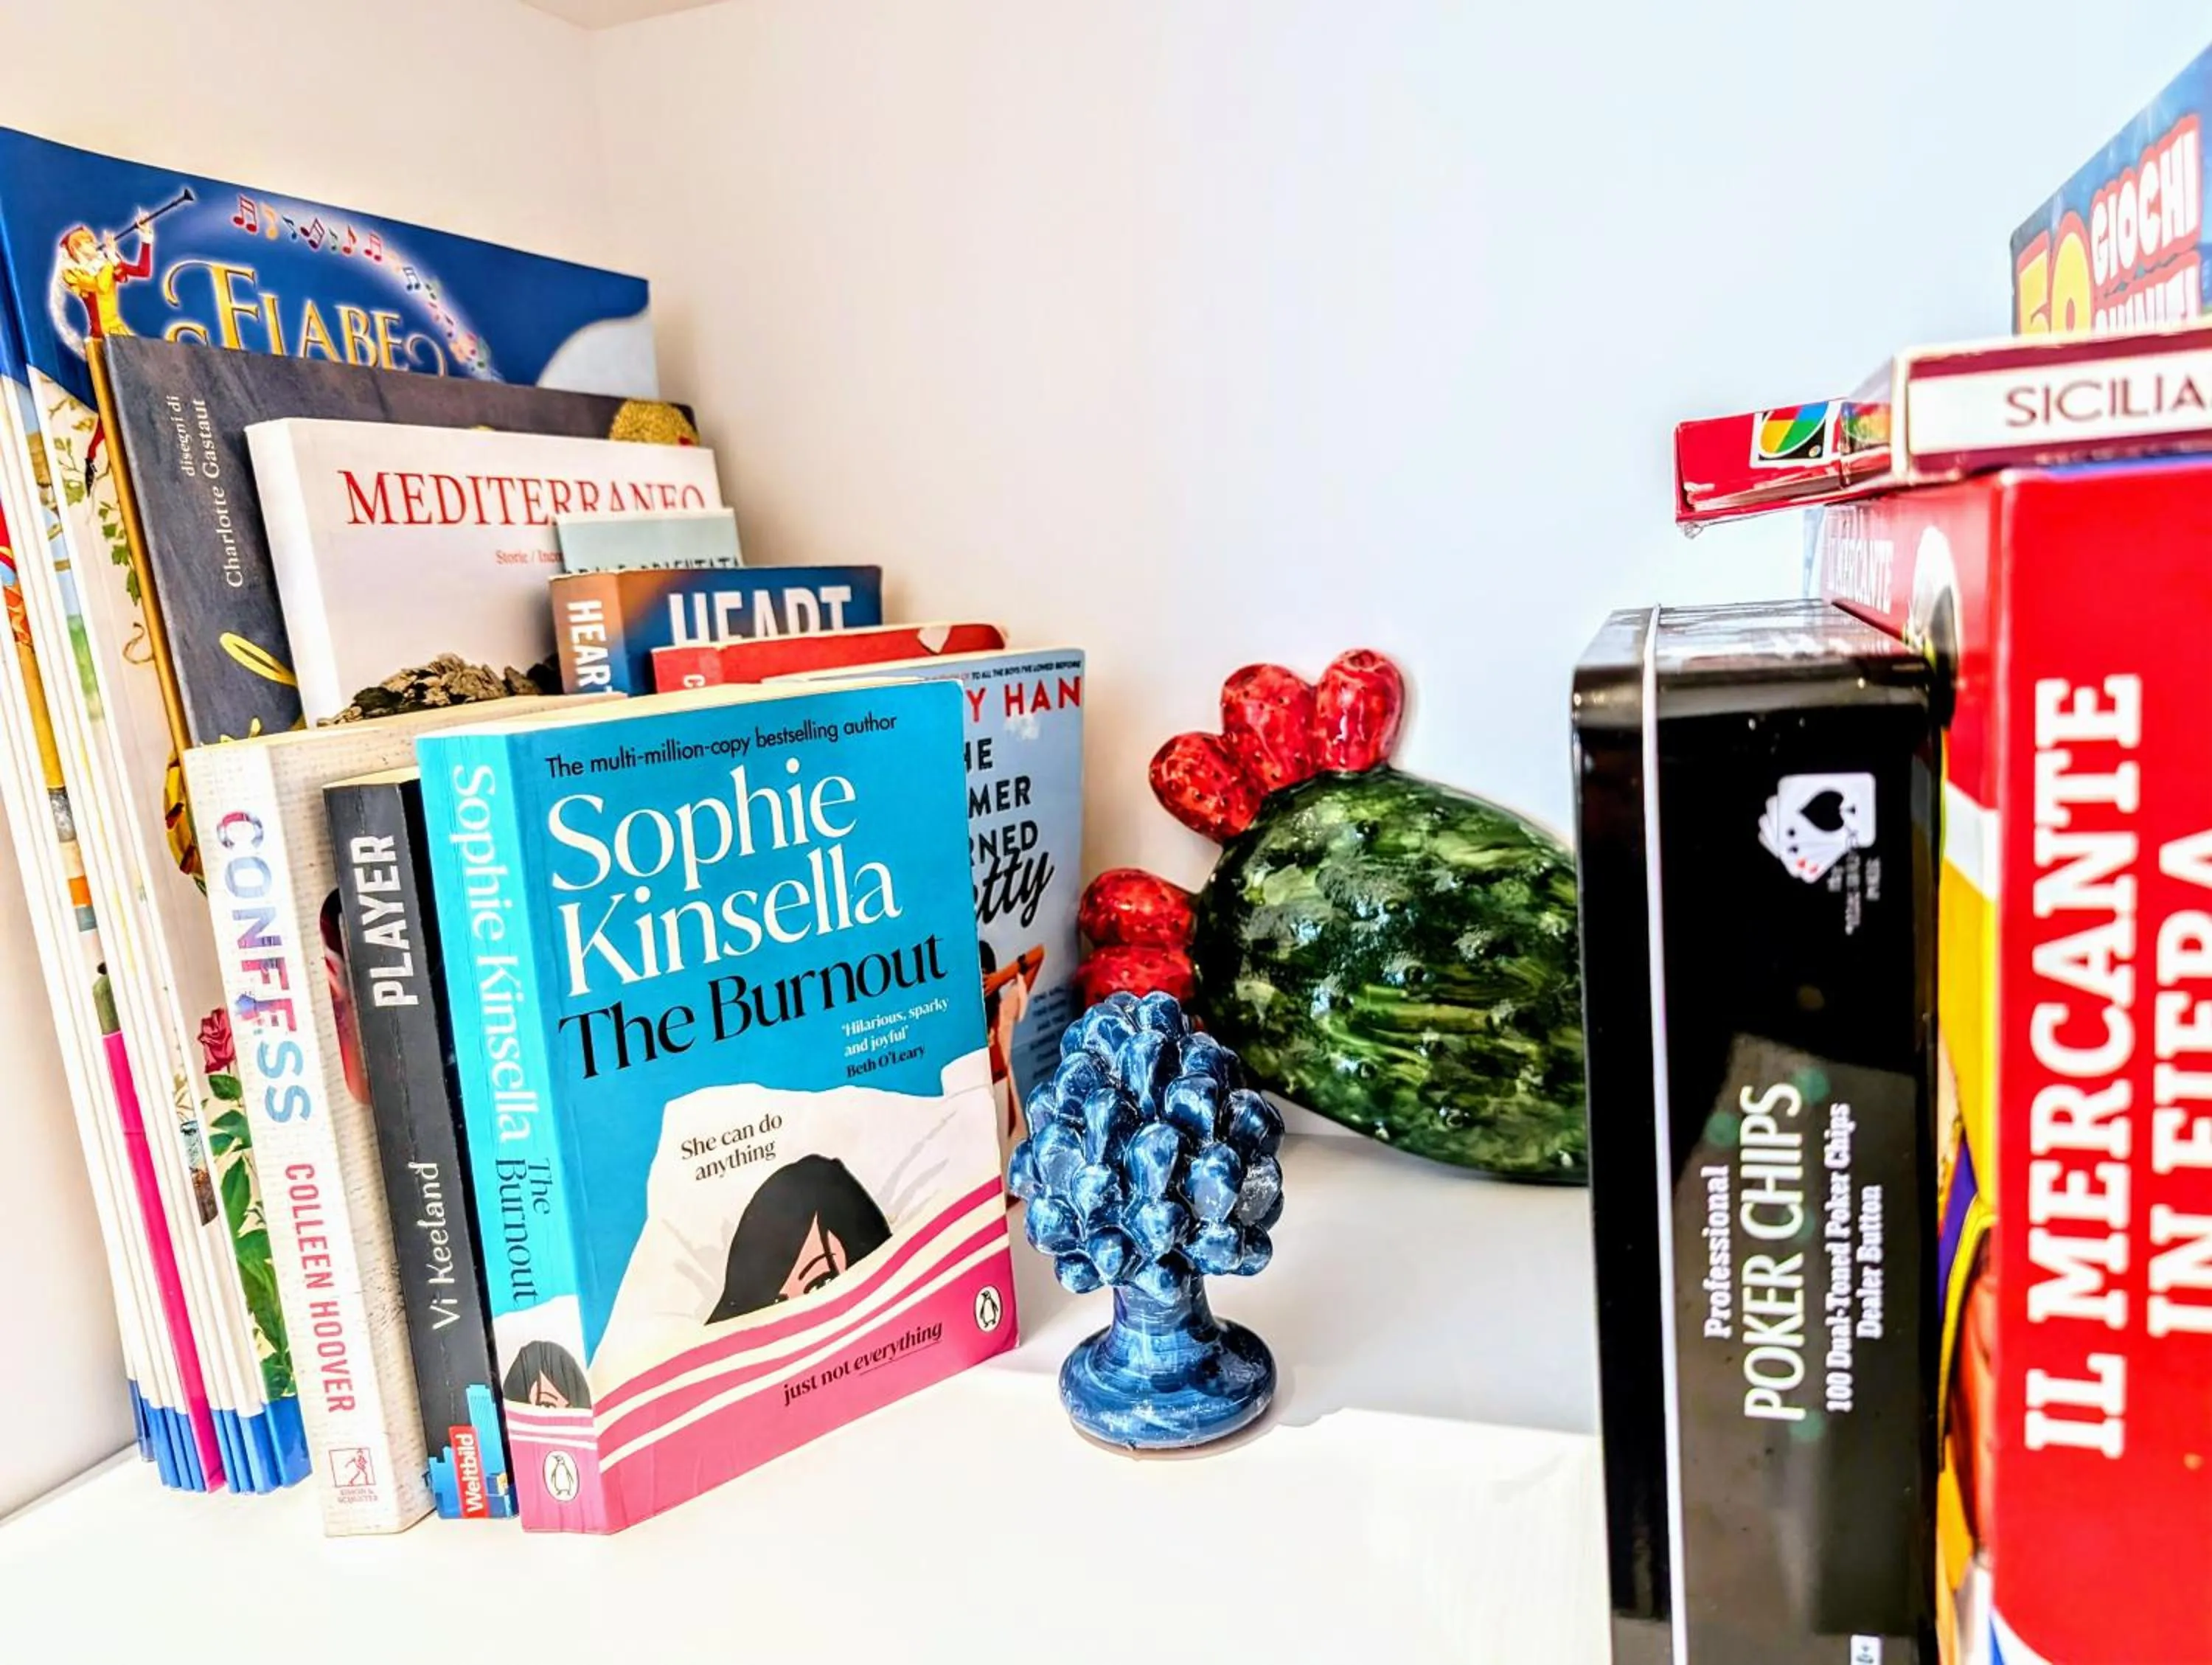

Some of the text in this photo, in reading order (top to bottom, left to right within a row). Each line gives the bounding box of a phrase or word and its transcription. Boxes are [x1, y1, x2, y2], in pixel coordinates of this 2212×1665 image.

[2091, 130, 2197, 287] GIOCHI
[167, 394, 195, 477] disegni di
[2005, 373, 2211, 428] SICILIA
[192, 398, 243, 588] Charlotte Gastaut
[566, 599, 613, 692] HEAR
[1004, 676, 1082, 717] HAN
[546, 711, 897, 779] The multi-million-copy bestselling author
[968, 776, 1031, 818] MER
[548, 757, 858, 891] Sophie
[216, 810, 311, 1123] CONFESS
[349, 835, 420, 1007] PLAYER
[449, 765, 539, 1143] Sophie Kinsella
[558, 843, 903, 997] Kinsella
[558, 1000, 695, 1080] The
[708, 934, 947, 1042] Burnout
[844, 1037, 868, 1057] and
[847, 1057, 876, 1077] Beth
[908, 998, 949, 1020] sparky
[2024, 672, 2142, 1460] IL MERCANTE
[527, 1157, 553, 1215] The
[681, 1113, 782, 1160] She can do
[695, 1141, 776, 1181] anything
[285, 1163, 355, 1414] COLLEEN HOOVER
[408, 1162, 461, 1330] Vi Keeland
[495, 1158, 538, 1310] Burnout
[1700, 1164, 1733, 1340] Professional
[1739, 1082, 1806, 1421] POKER CHIPS
[1823, 1102, 1857, 1413] 100 Dual-Toned Poker Chips
[1856, 1183, 1884, 1340] Dealer Button
[783, 1321, 943, 1407] just not everything
[455, 1433, 484, 1512] Weltbild
